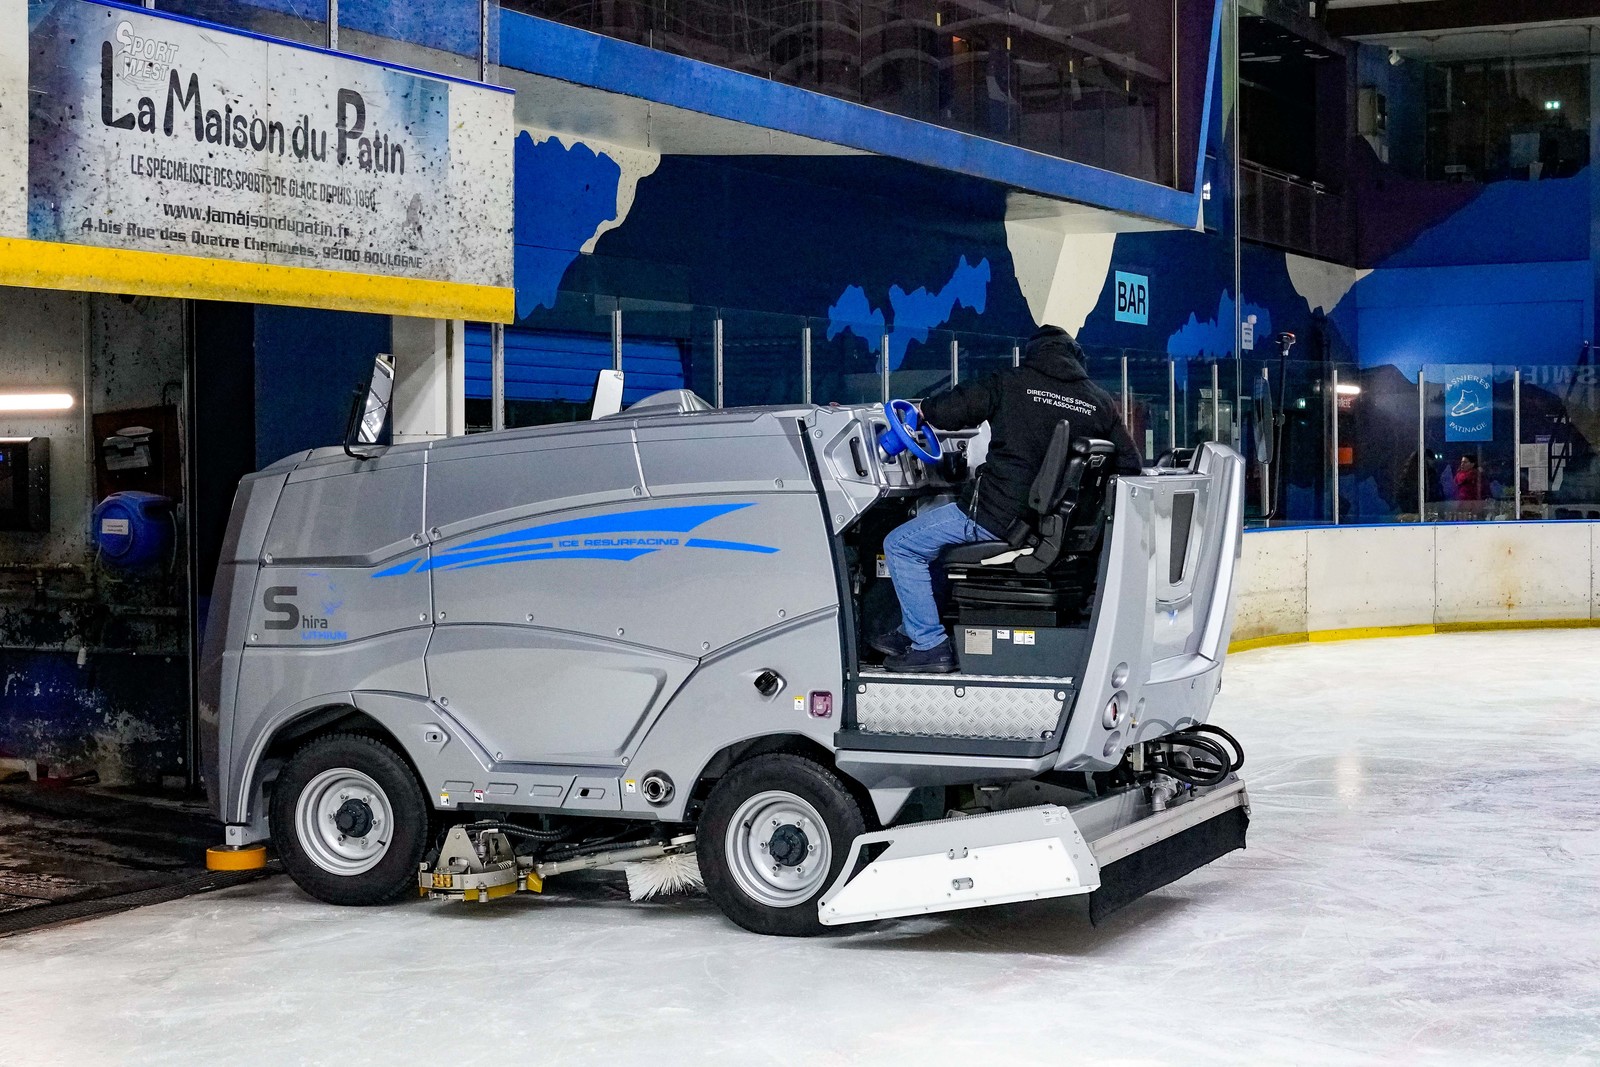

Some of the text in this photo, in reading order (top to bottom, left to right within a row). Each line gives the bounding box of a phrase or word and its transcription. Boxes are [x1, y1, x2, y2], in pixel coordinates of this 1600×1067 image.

[115, 21, 180, 64] SPORT
[122, 57, 170, 81] WEST
[101, 40, 405, 176] La Maison du Patin
[130, 154, 144, 176] LE
[146, 155, 211, 186] SPÉCIALISTE
[214, 167, 234, 189] DES
[235, 171, 272, 194] SPORTS
[274, 175, 287, 197] DE
[289, 178, 317, 201] GLACE
[319, 183, 351, 206] DEPUIS
[126, 222, 156, 240] Rue
[160, 226, 187, 243] des
[191, 230, 240, 249] Quatre
[322, 246, 361, 263] 92100
[364, 251, 423, 269] BOULOGNE
[1117, 281, 1146, 315] BAR
[1026, 388, 1097, 411] DIRECTION DES SPORTS
[1053, 400, 1092, 416] ASSOCIATIVE
[1449, 421, 1488, 433] PATINAGE
[559, 538, 680, 548] ICE RESURFACING
[301, 630, 348, 641] LITHIUM
